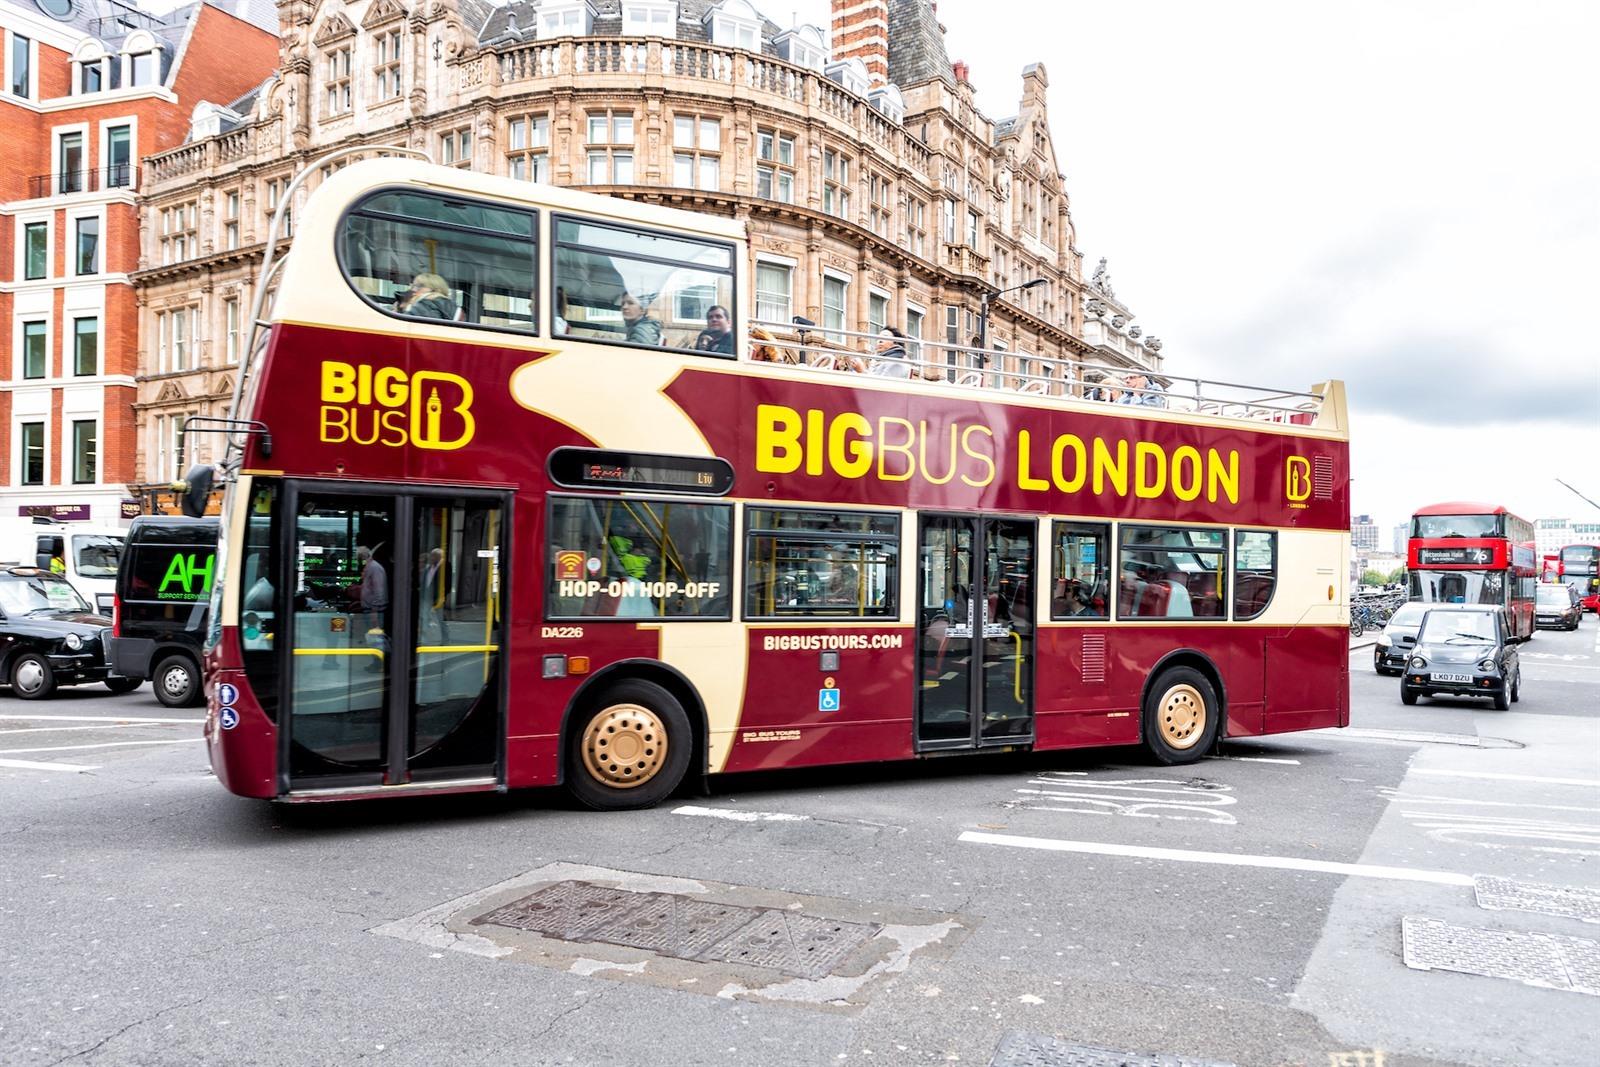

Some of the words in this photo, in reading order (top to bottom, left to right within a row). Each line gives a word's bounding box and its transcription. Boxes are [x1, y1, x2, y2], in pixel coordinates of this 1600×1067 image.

[321, 361, 409, 407] BIG
[320, 405, 408, 447] BUS
[1018, 429, 1239, 504] LONDON
[1472, 550, 1488, 561] 76
[158, 553, 214, 593] AH
[559, 581, 635, 598] HOP-ON
[639, 581, 721, 599] HOP-OFF
[541, 626, 584, 639] DA226
[763, 634, 903, 651] BIGBUSTOURS.COM
